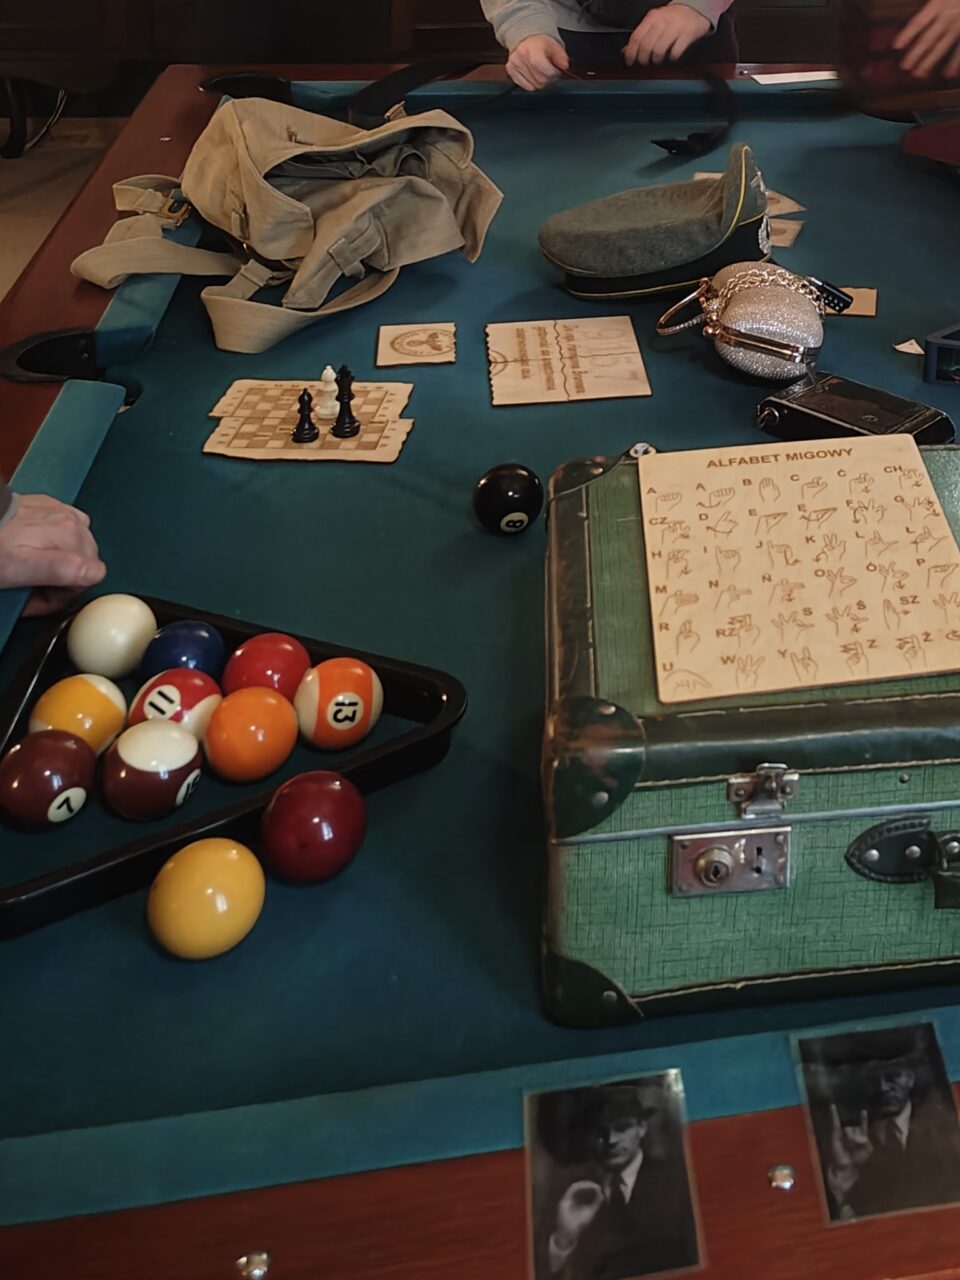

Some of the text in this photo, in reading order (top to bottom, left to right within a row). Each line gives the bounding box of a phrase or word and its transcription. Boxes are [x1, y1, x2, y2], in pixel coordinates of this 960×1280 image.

[706, 448, 853, 469] ALFABET MIGOWY
[884, 465, 902, 474] CH
[505, 519, 525, 529] 8
[648, 516, 668, 525] CZ
[900, 595, 920, 605] SZ
[715, 627, 737, 638] RZ
[148, 689, 176, 715] 11
[333, 702, 358, 723] 13
[56, 796, 75, 814] 7
